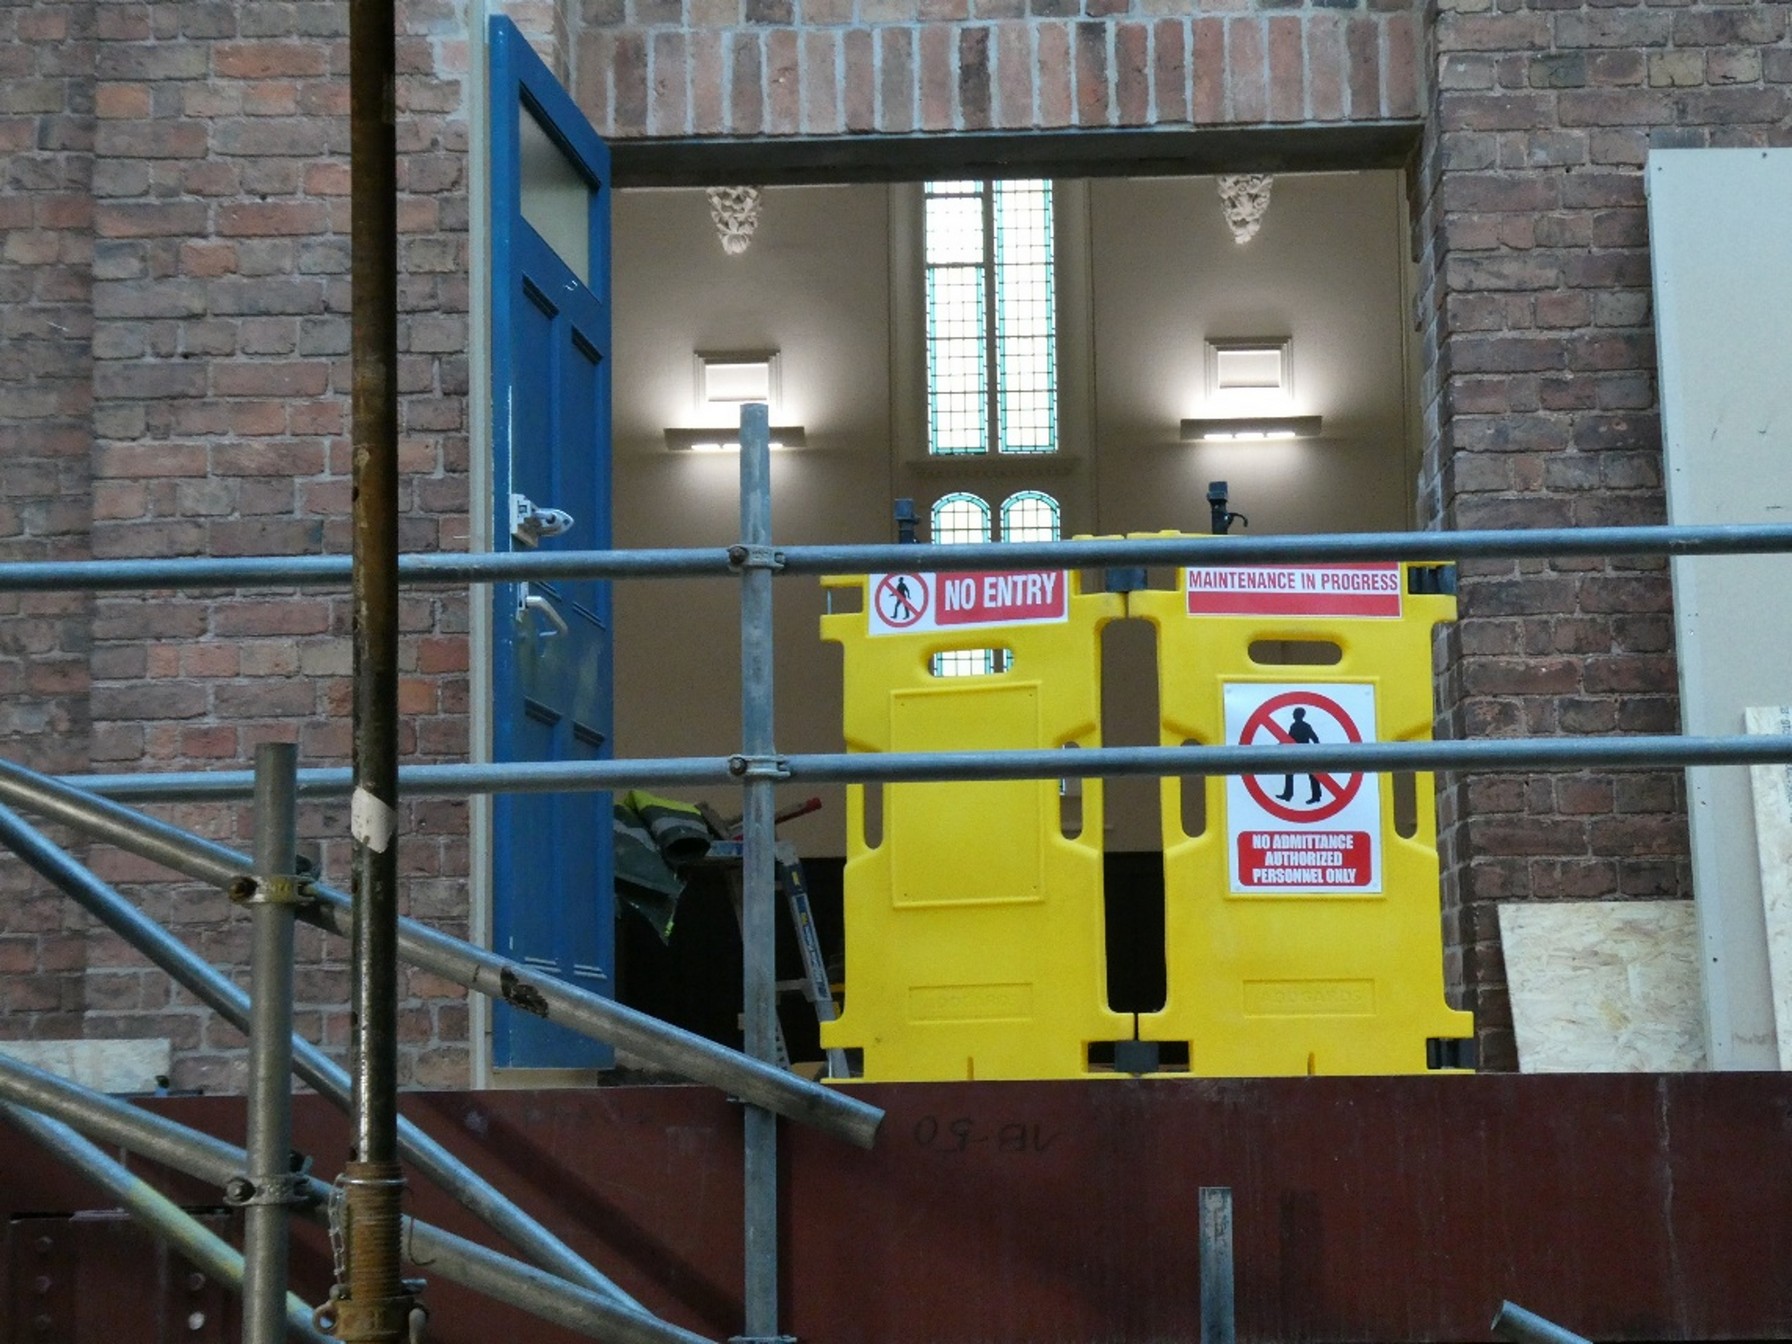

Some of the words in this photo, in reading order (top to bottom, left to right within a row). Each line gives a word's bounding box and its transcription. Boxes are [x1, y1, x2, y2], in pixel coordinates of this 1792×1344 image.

[1189, 570, 1296, 589] MAINTENANCE
[1301, 572, 1316, 590] IN
[1321, 573, 1398, 591] PROGRESS
[944, 580, 976, 611] NO
[983, 572, 1057, 608] ENTRY
[1252, 834, 1271, 849] NO
[1272, 834, 1354, 849] ADMITTANCE
[1264, 851, 1343, 866] AUTHORIZED
[1252, 868, 1324, 883] PERSONNEL
[1325, 868, 1357, 883] ONLY
